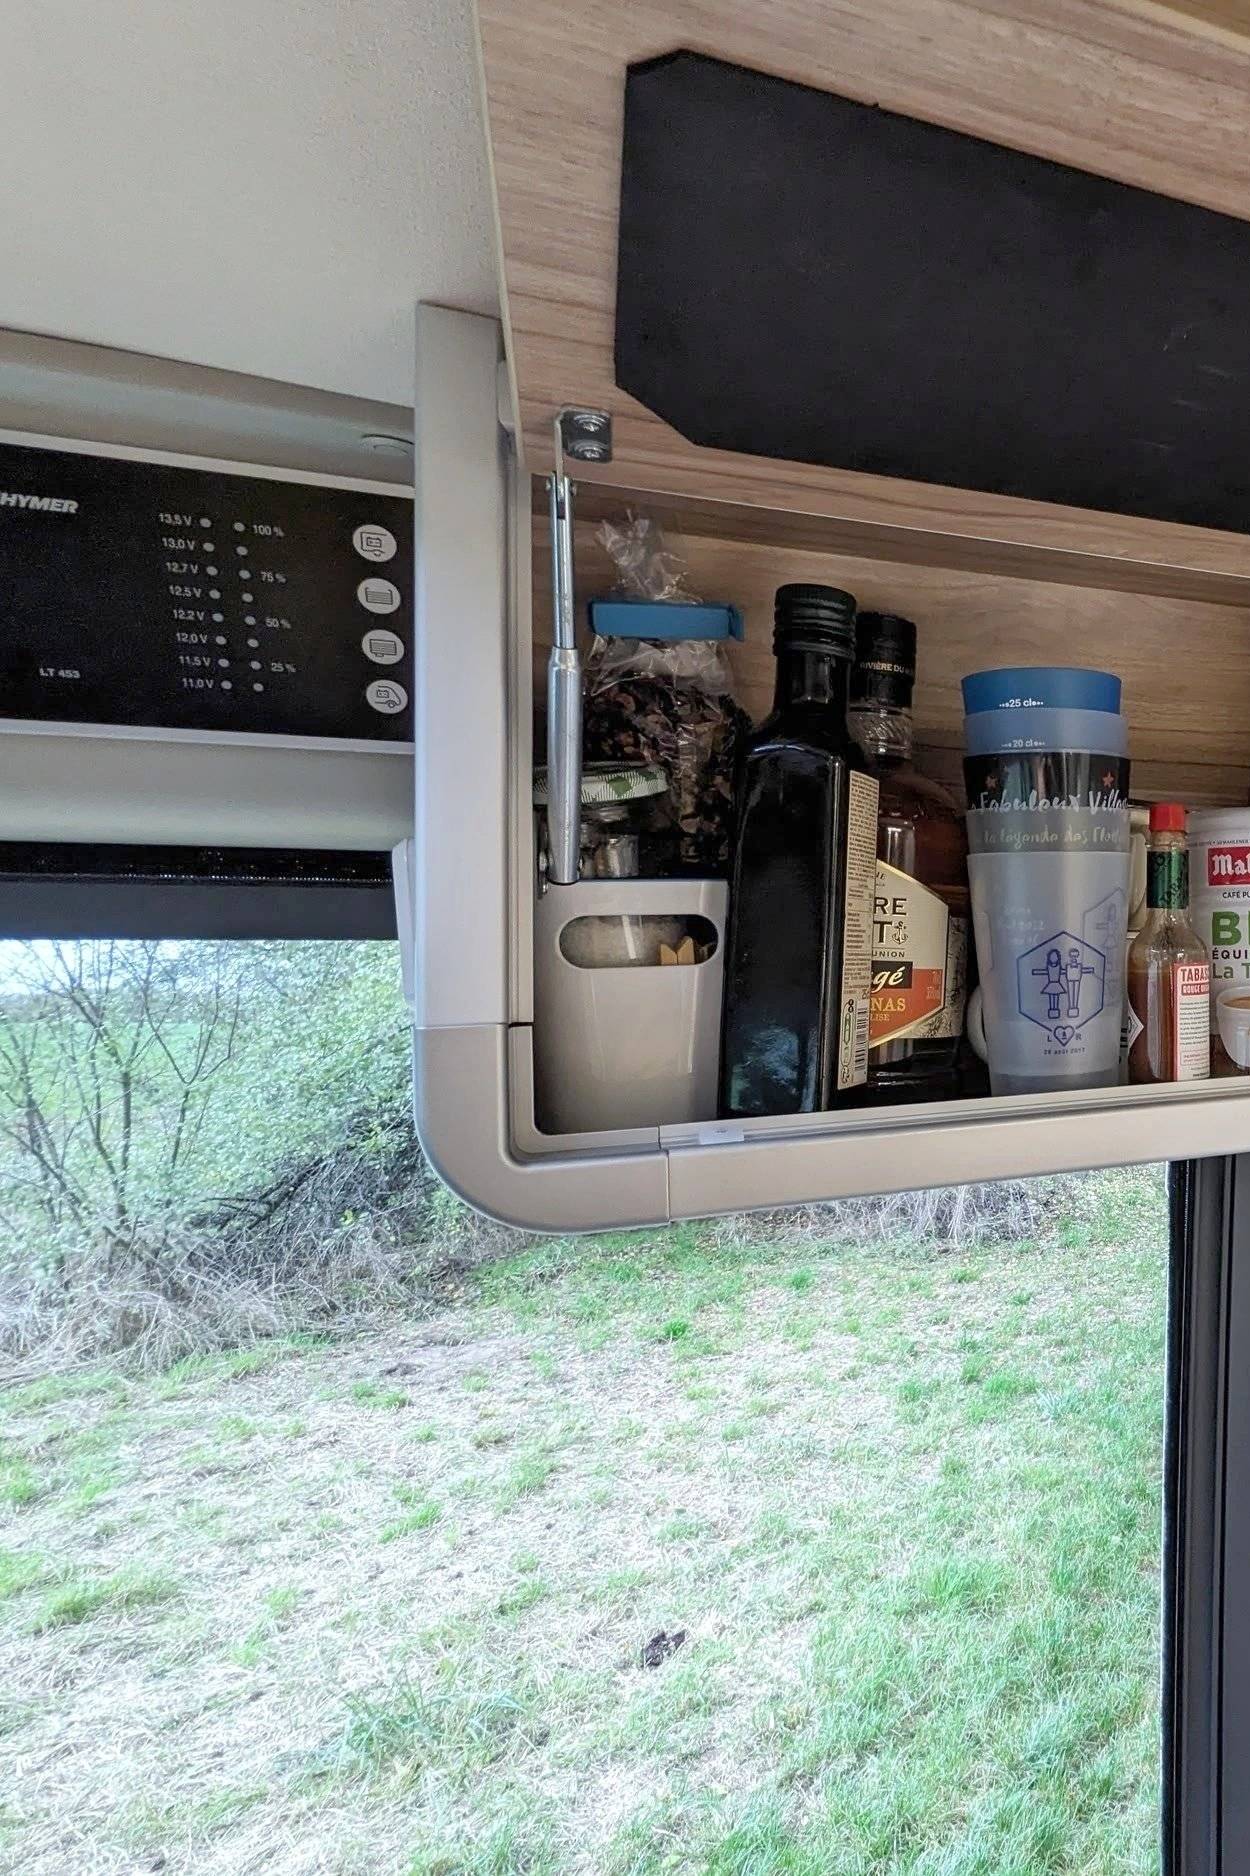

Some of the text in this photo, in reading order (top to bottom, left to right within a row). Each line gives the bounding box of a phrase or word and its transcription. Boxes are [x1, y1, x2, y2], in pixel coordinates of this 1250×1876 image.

[0, 492, 79, 513] HYMER
[183, 515, 192, 526] V
[252, 524, 272, 536] 100
[187, 539, 196, 551] V
[190, 563, 199, 574] V
[193, 586, 202, 598] V
[196, 610, 205, 621] V
[199, 633, 208, 644] V
[202, 656, 211, 668] V
[270, 662, 284, 673] 25
[205, 679, 214, 689] V
[1009, 698, 1021, 708] 25
[1012, 739, 1024, 748] 20
[1222, 890, 1240, 899] CAFÉ
[874, 896, 907, 916] RE
[873, 920, 893, 943] T
[1212, 963, 1234, 979] La
[871, 966, 906, 993] gé
[871, 997, 906, 1013] NAS
